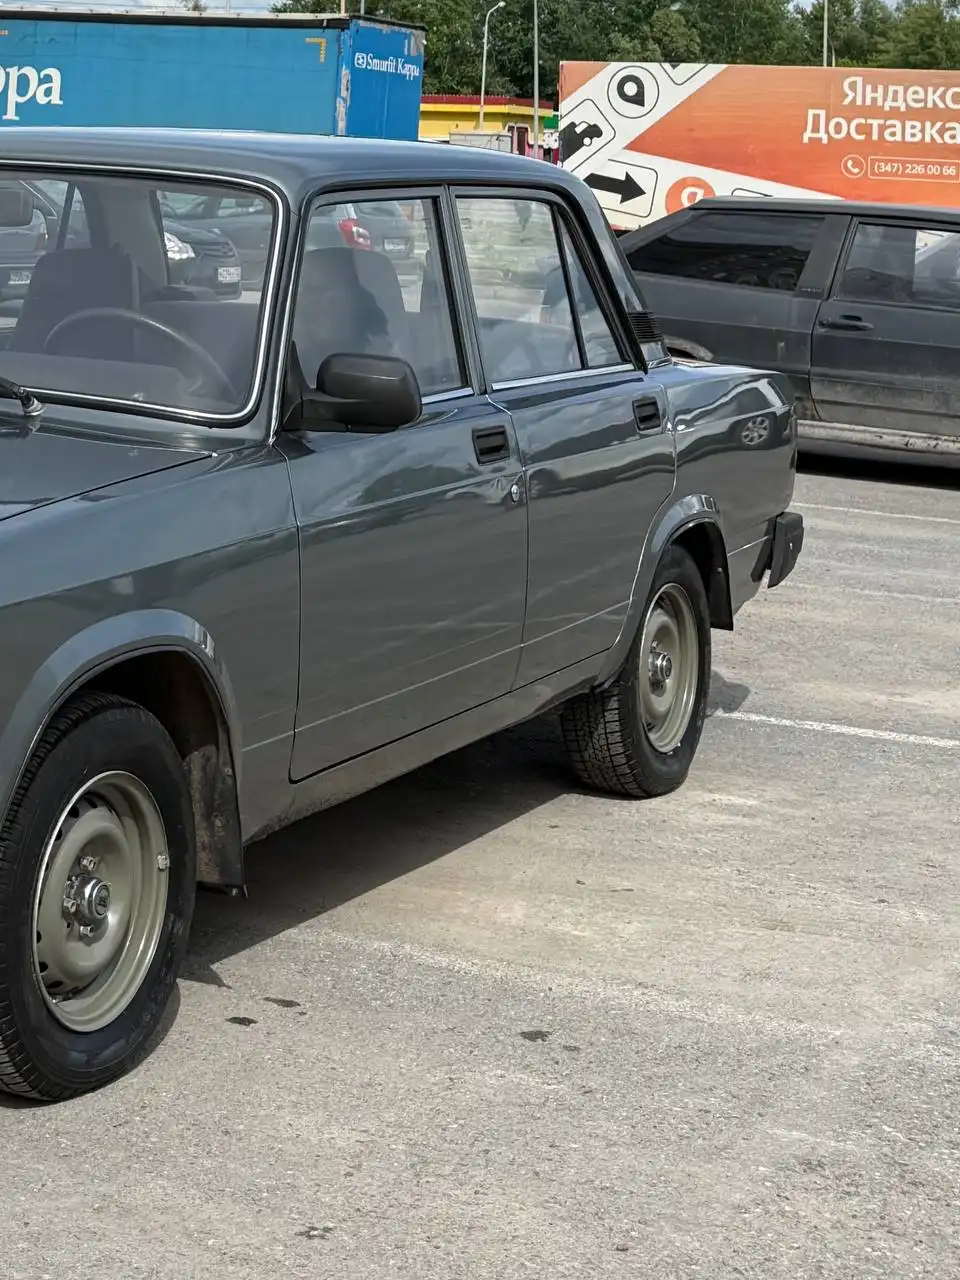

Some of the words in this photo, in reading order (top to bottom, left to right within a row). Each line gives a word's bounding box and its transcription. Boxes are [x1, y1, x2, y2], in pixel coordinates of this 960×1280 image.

[367, 53, 396, 73] Smurfit
[841, 76, 960, 111] Яндекс
[802, 109, 960, 144] Доставка
[874, 161, 903, 175] (347)
[905, 163, 926, 174] 226
[927, 164, 941, 176] 00
